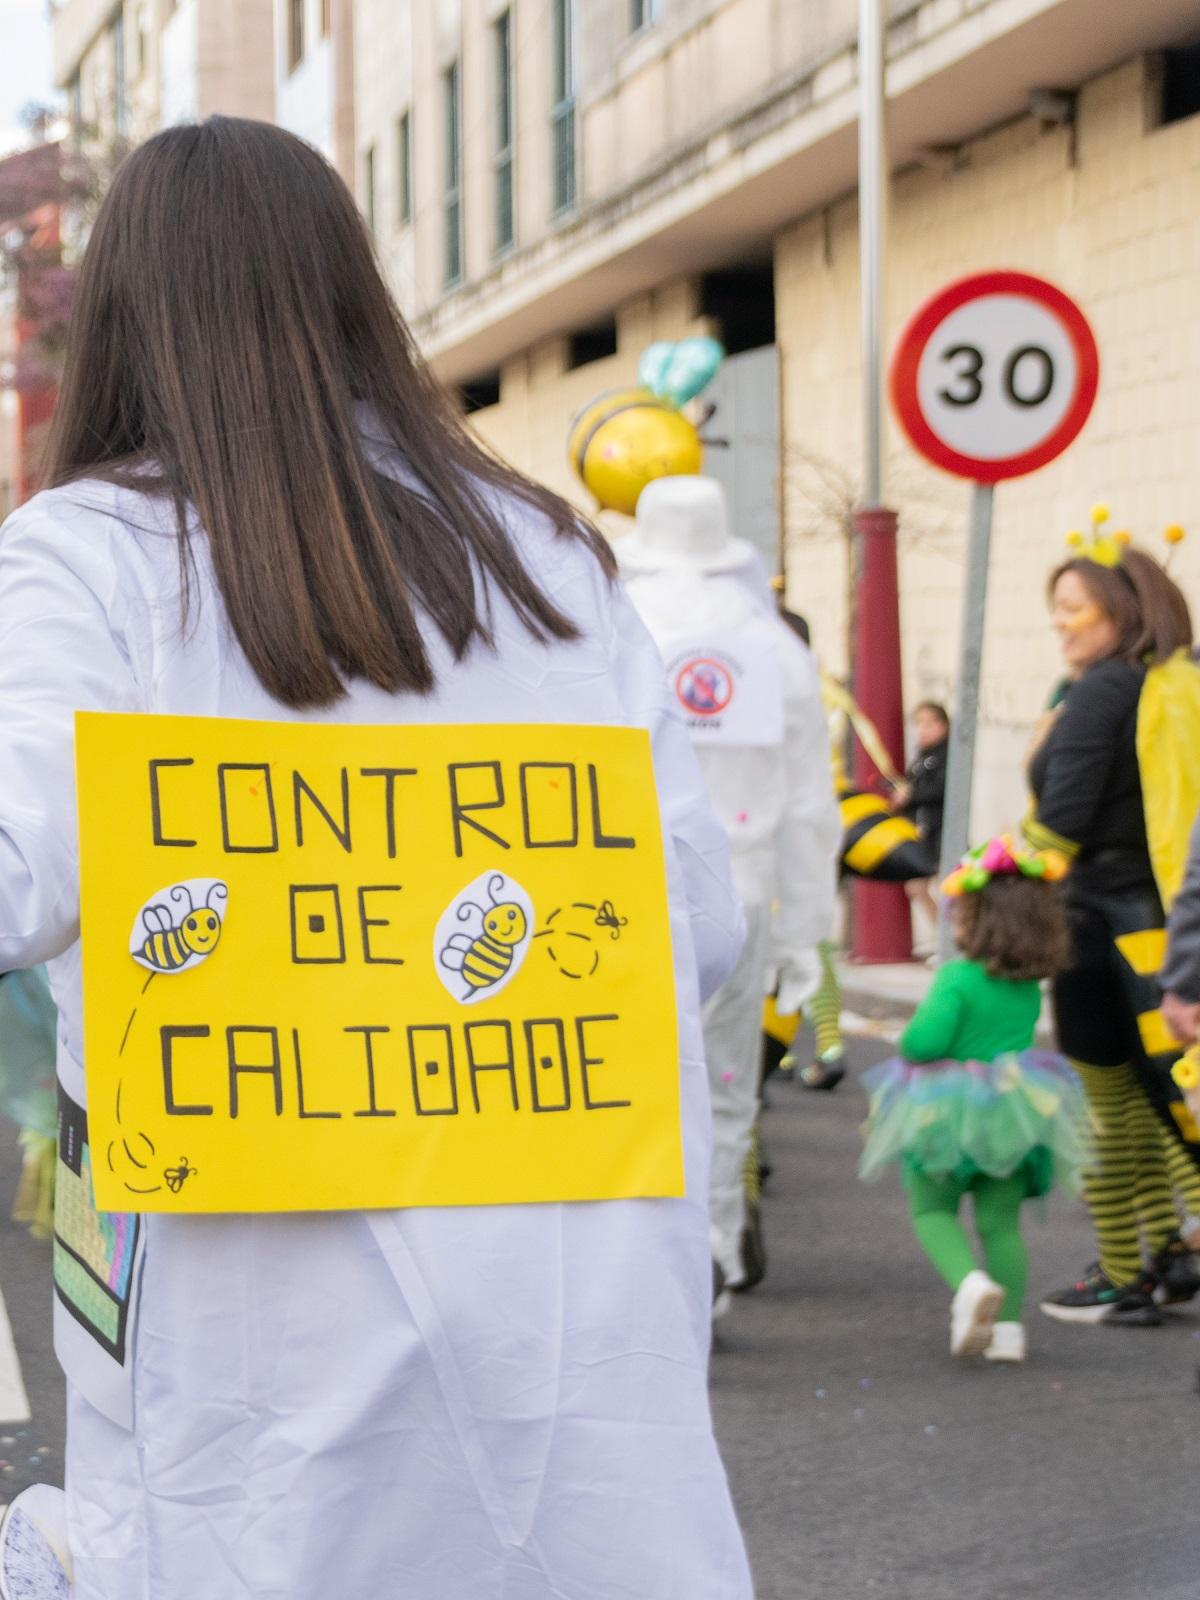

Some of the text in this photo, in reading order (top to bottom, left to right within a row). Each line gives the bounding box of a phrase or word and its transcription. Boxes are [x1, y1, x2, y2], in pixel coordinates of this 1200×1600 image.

[938, 343, 1057, 410] 30
[148, 757, 636, 859] CONTROL
[289, 883, 405, 965] DE
[159, 1013, 632, 1120] CALIDADE
